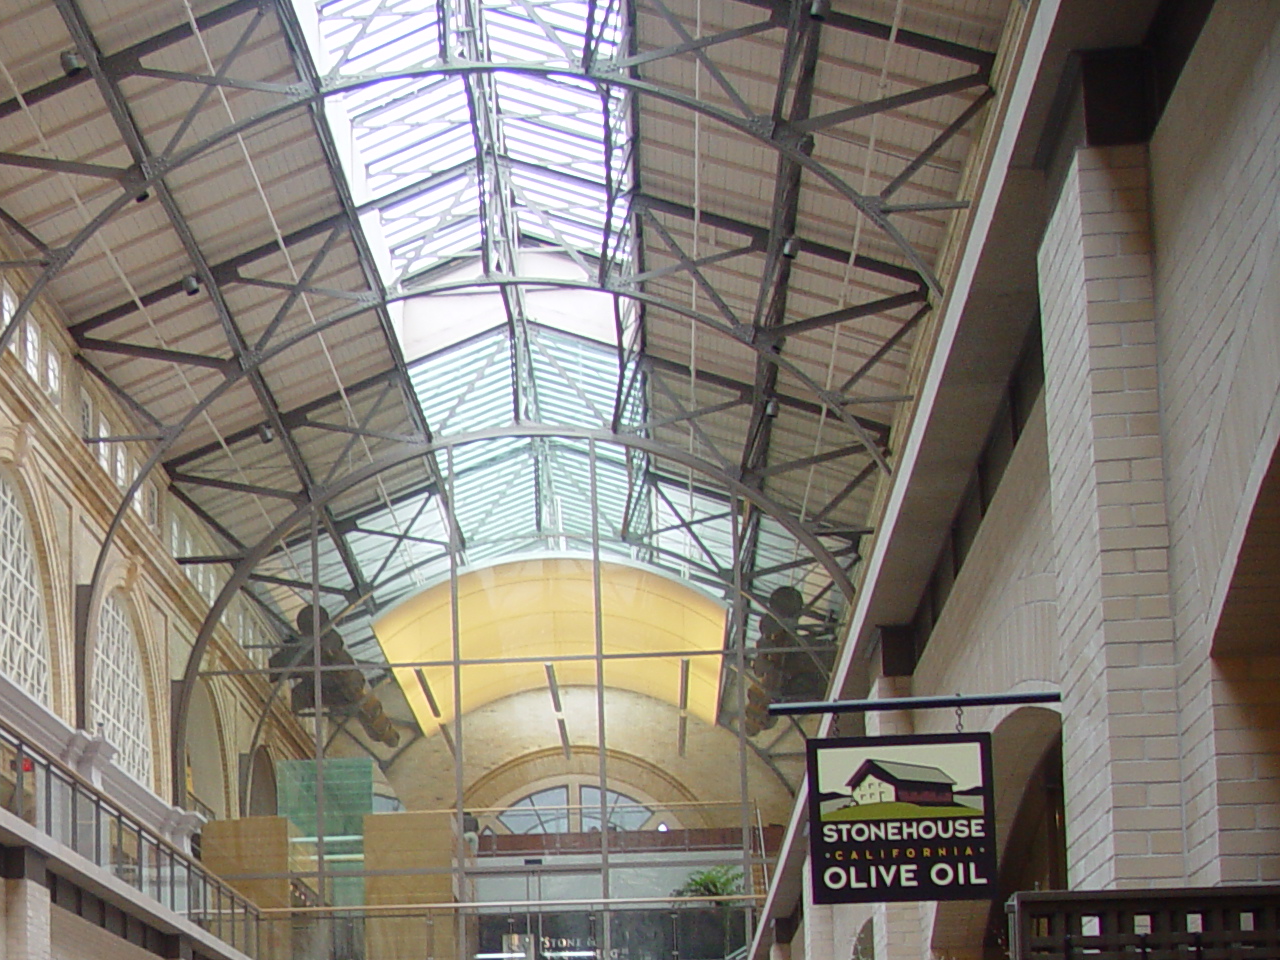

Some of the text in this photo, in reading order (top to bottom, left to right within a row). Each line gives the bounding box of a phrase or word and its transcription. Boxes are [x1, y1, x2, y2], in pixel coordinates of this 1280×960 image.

[822, 819, 986, 843] STONEHOUSE
[834, 846, 974, 861] CALIFORNIA
[823, 862, 988, 890] OLIVE OIL
